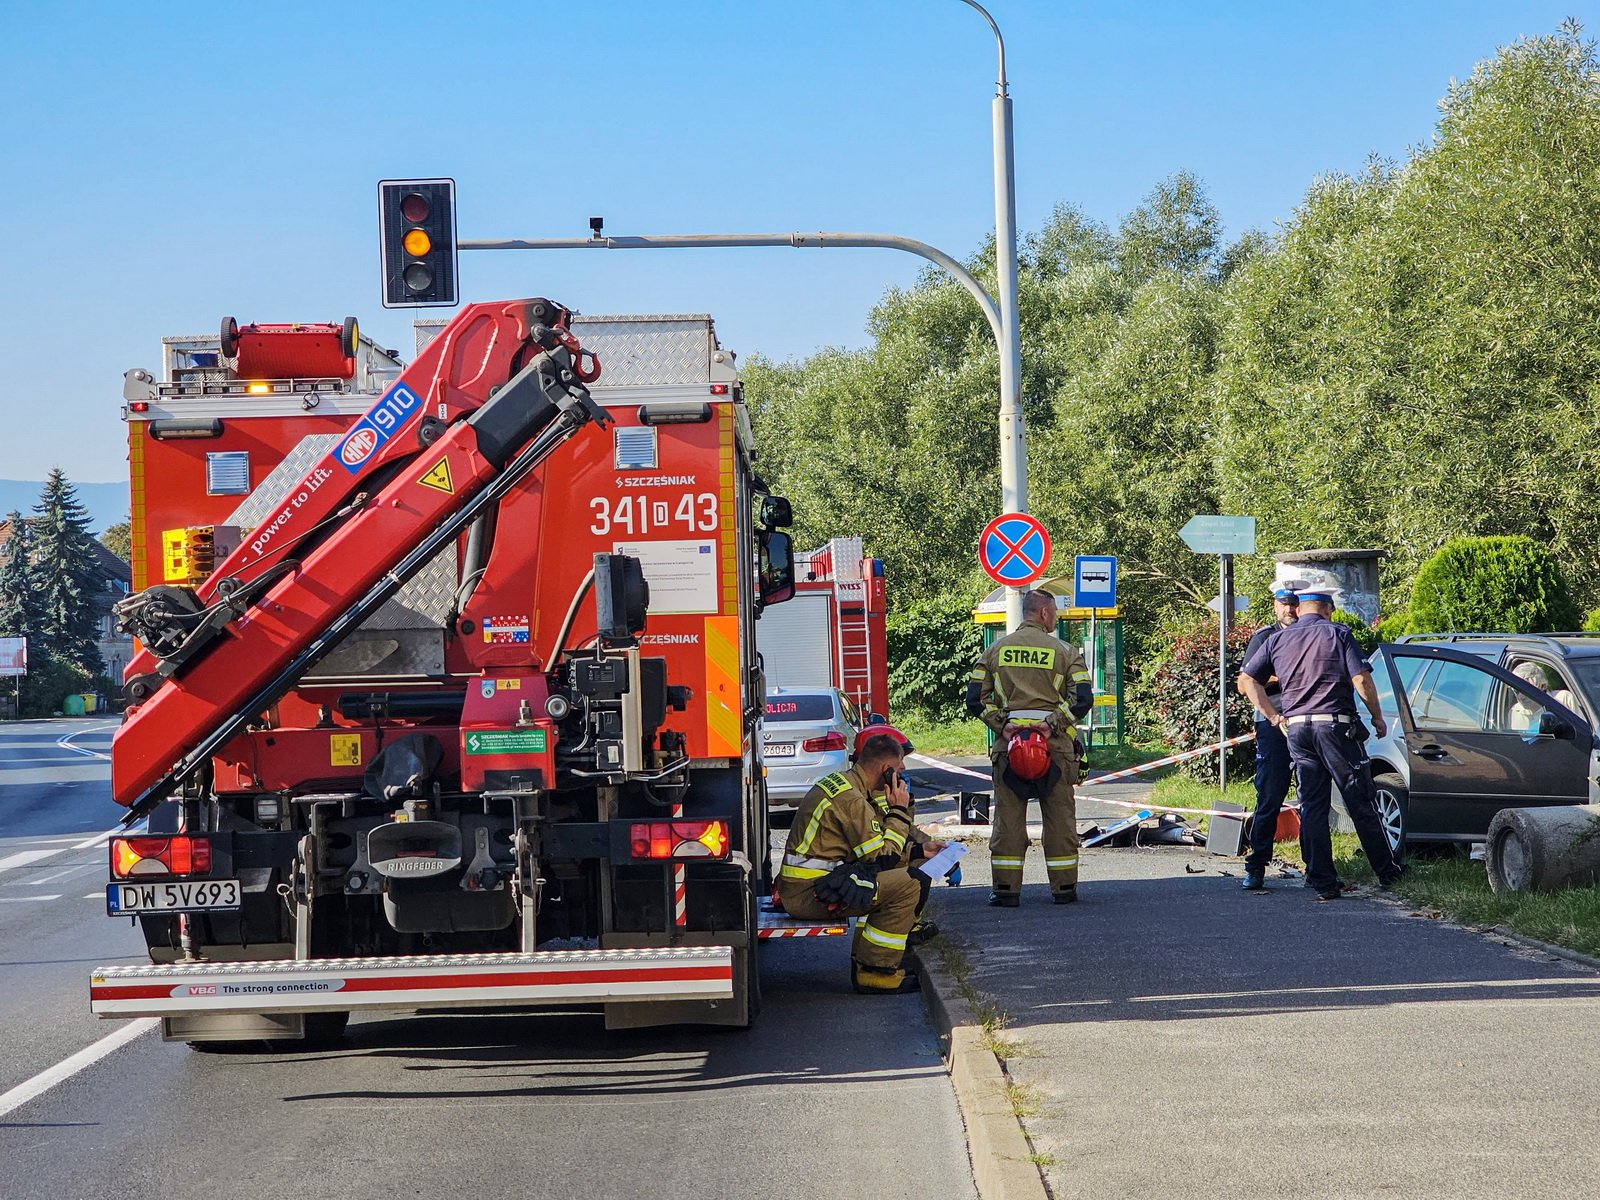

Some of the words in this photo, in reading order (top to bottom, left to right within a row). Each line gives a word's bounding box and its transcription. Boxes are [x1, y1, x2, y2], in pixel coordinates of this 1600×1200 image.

[374, 387, 415, 430] 910
[343, 431, 375, 462] HMF
[624, 475, 696, 488] SZCZĘŚNIAK
[590, 496, 648, 535] 341
[674, 492, 718, 532] 43
[250, 506, 293, 555] power
[291, 490, 309, 511] to
[639, 633, 699, 646] CZĘŚNIAK
[766, 702, 797, 714] OLICJA
[387, 859, 444, 872] RINGFEDER
[123, 887, 156, 909] DW
[165, 883, 236, 906] 5V693
[190, 985, 216, 995] VBG
[223, 984, 239, 994] The
[243, 984, 274, 995] strong
[277, 981, 329, 993] connection
